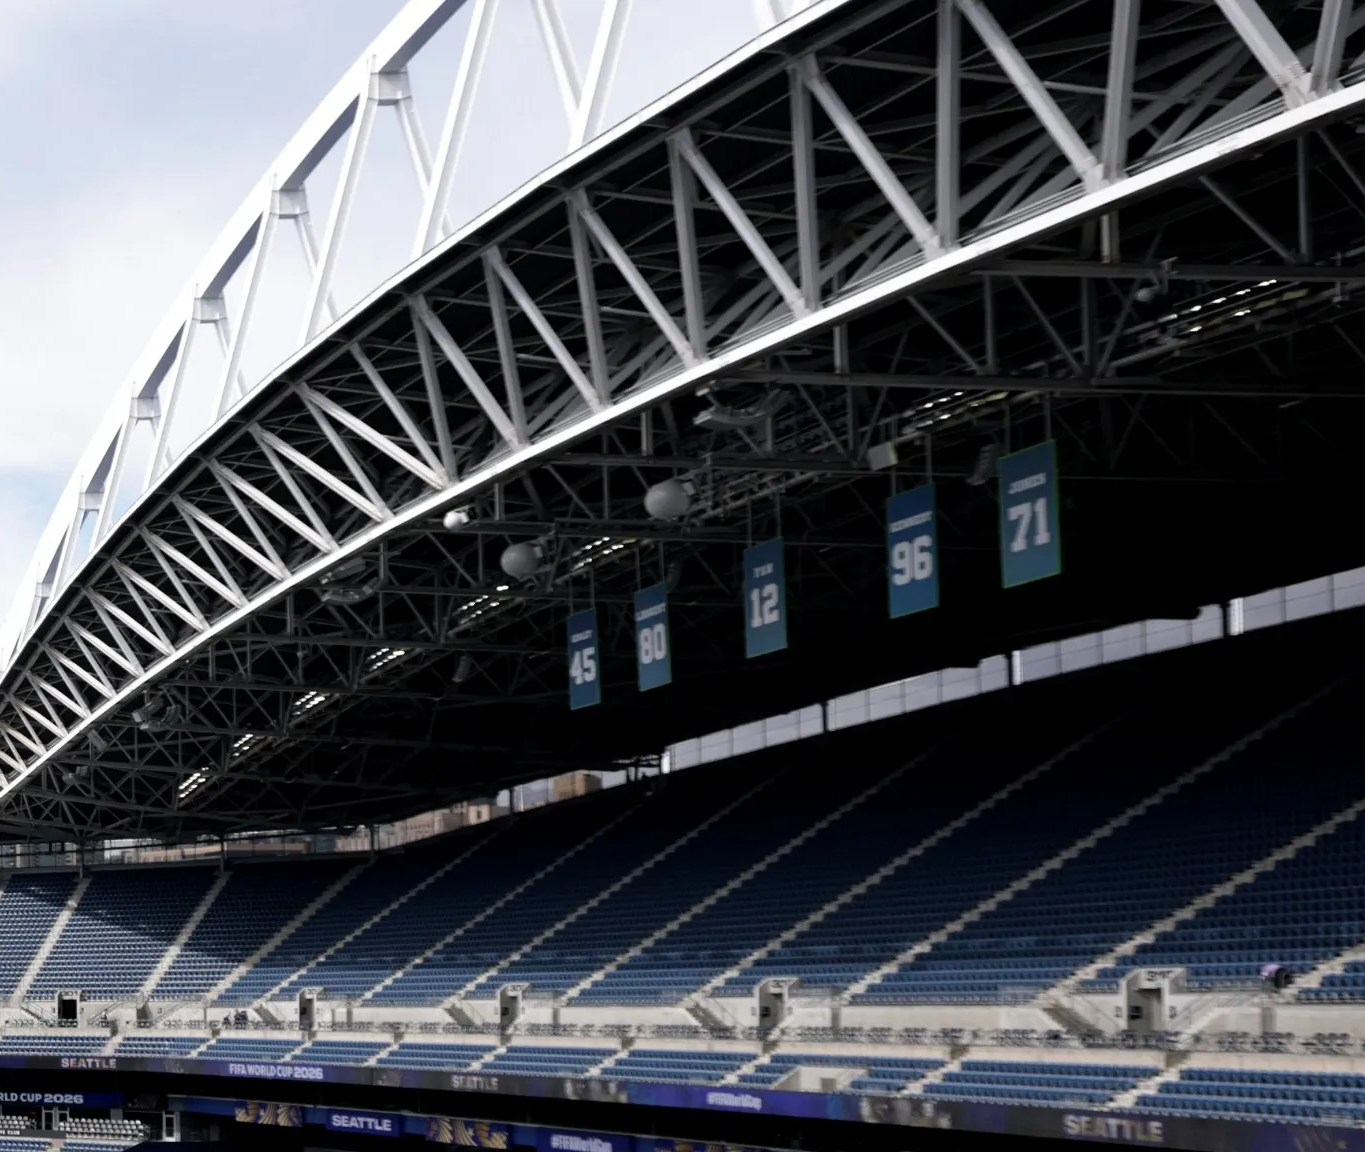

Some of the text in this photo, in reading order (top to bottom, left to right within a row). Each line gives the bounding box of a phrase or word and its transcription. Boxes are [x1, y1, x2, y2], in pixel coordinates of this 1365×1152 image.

[1007, 497, 1052, 552] 71
[891, 534, 934, 586] 96
[750, 582, 780, 629] 12
[639, 623, 668, 665] 80
[569, 646, 597, 686] 45
[60, 1057, 117, 1069] SEATTLE
[229, 1063, 325, 1080] FIFA WORLD CUP 2026
[450, 1073, 499, 1091] SEATTLE
[19, 1092, 42, 1103] CUP
[43, 1093, 85, 1105] 2026
[330, 1113, 392, 1132] SEATTLE
[1063, 1114, 1164, 1143] SEATTLE
